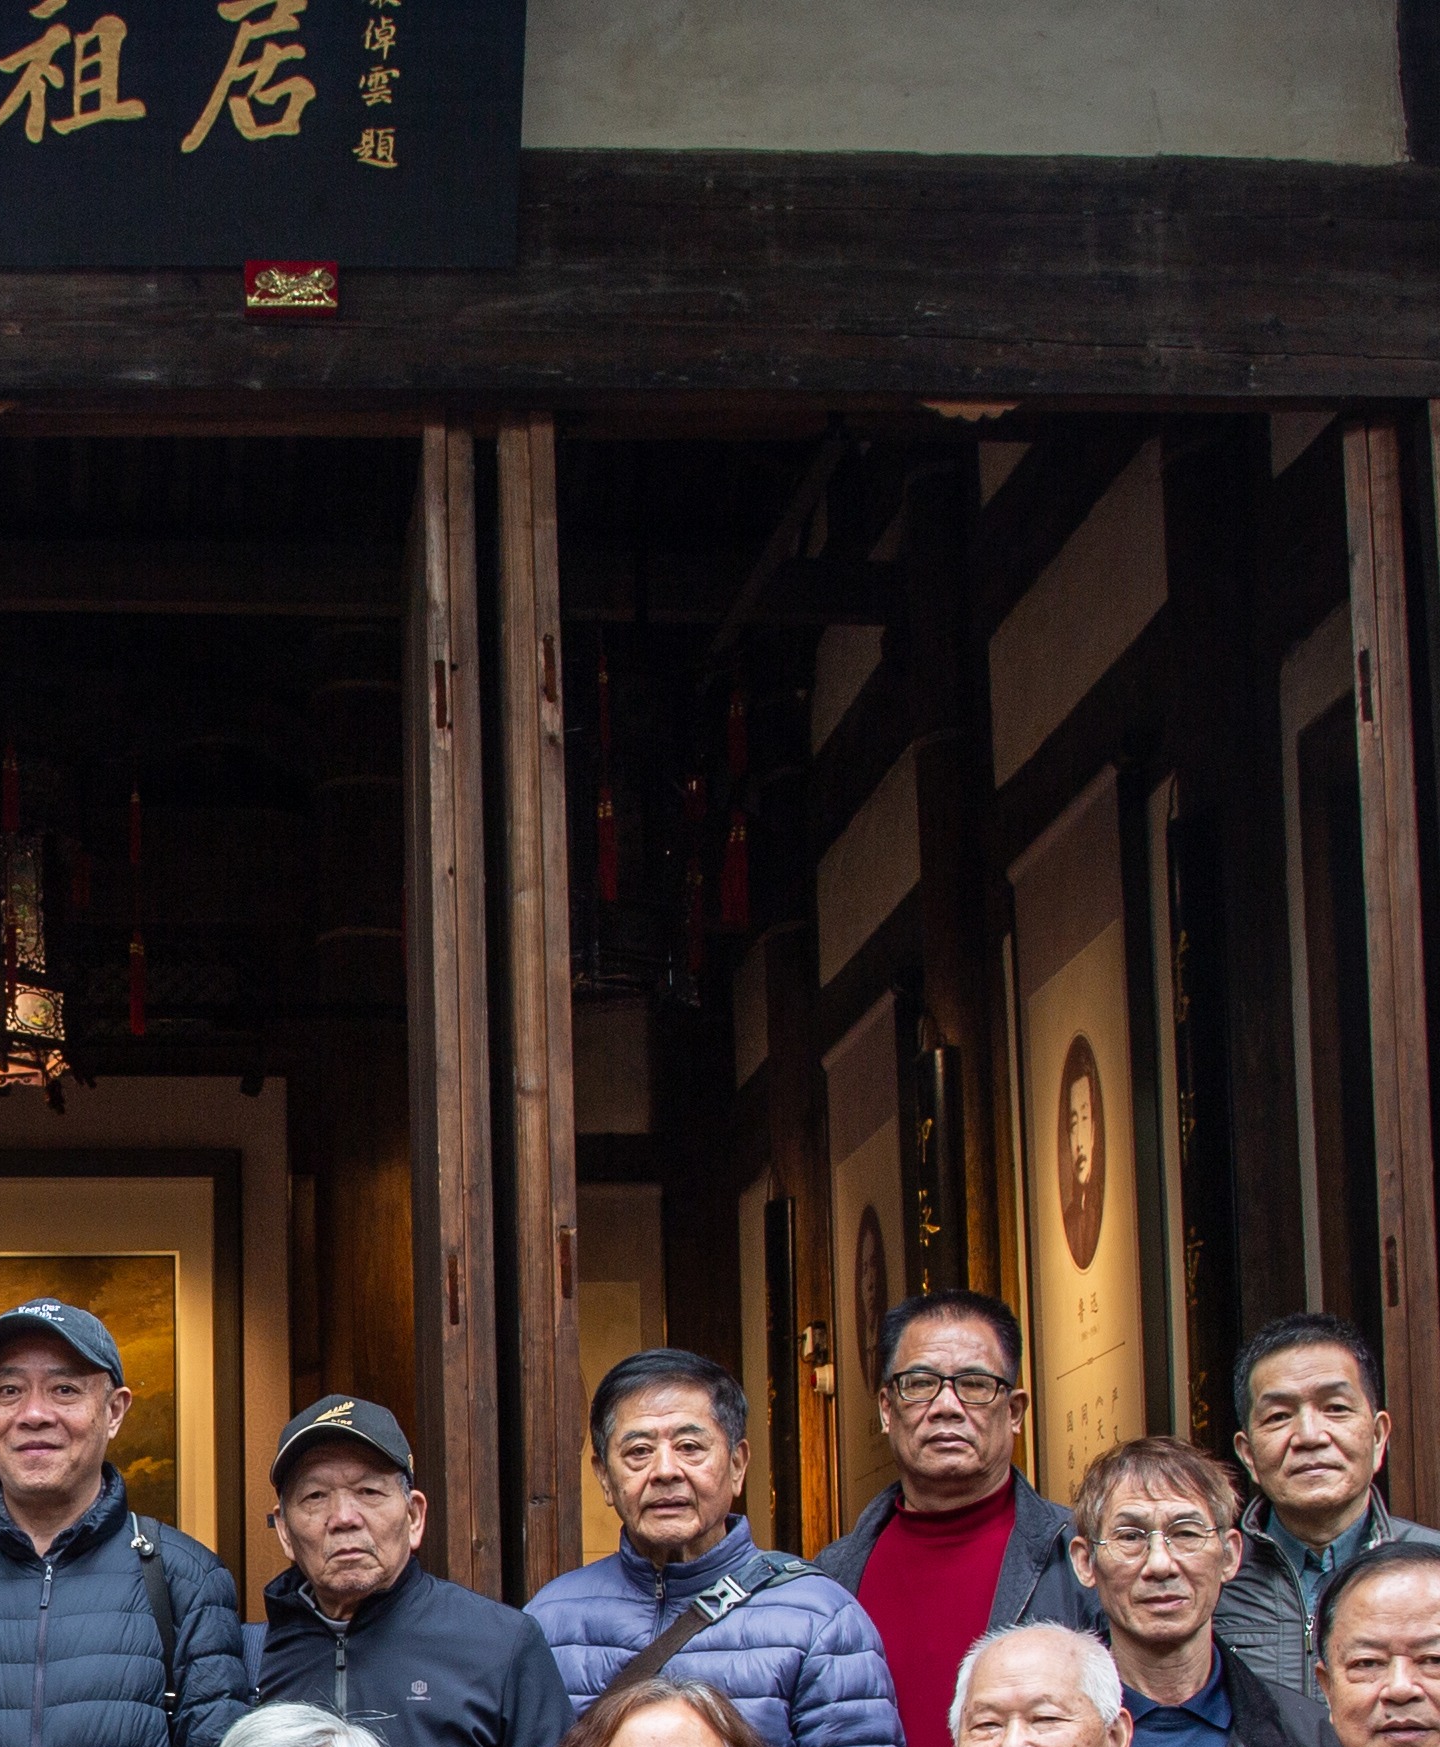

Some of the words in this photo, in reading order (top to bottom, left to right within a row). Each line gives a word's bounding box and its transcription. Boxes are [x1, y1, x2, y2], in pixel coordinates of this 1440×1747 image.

[351, 0, 401, 169] 倬雲題
[18, 1306, 41, 1315] Keep
[42, 1304, 61, 1312] Our
